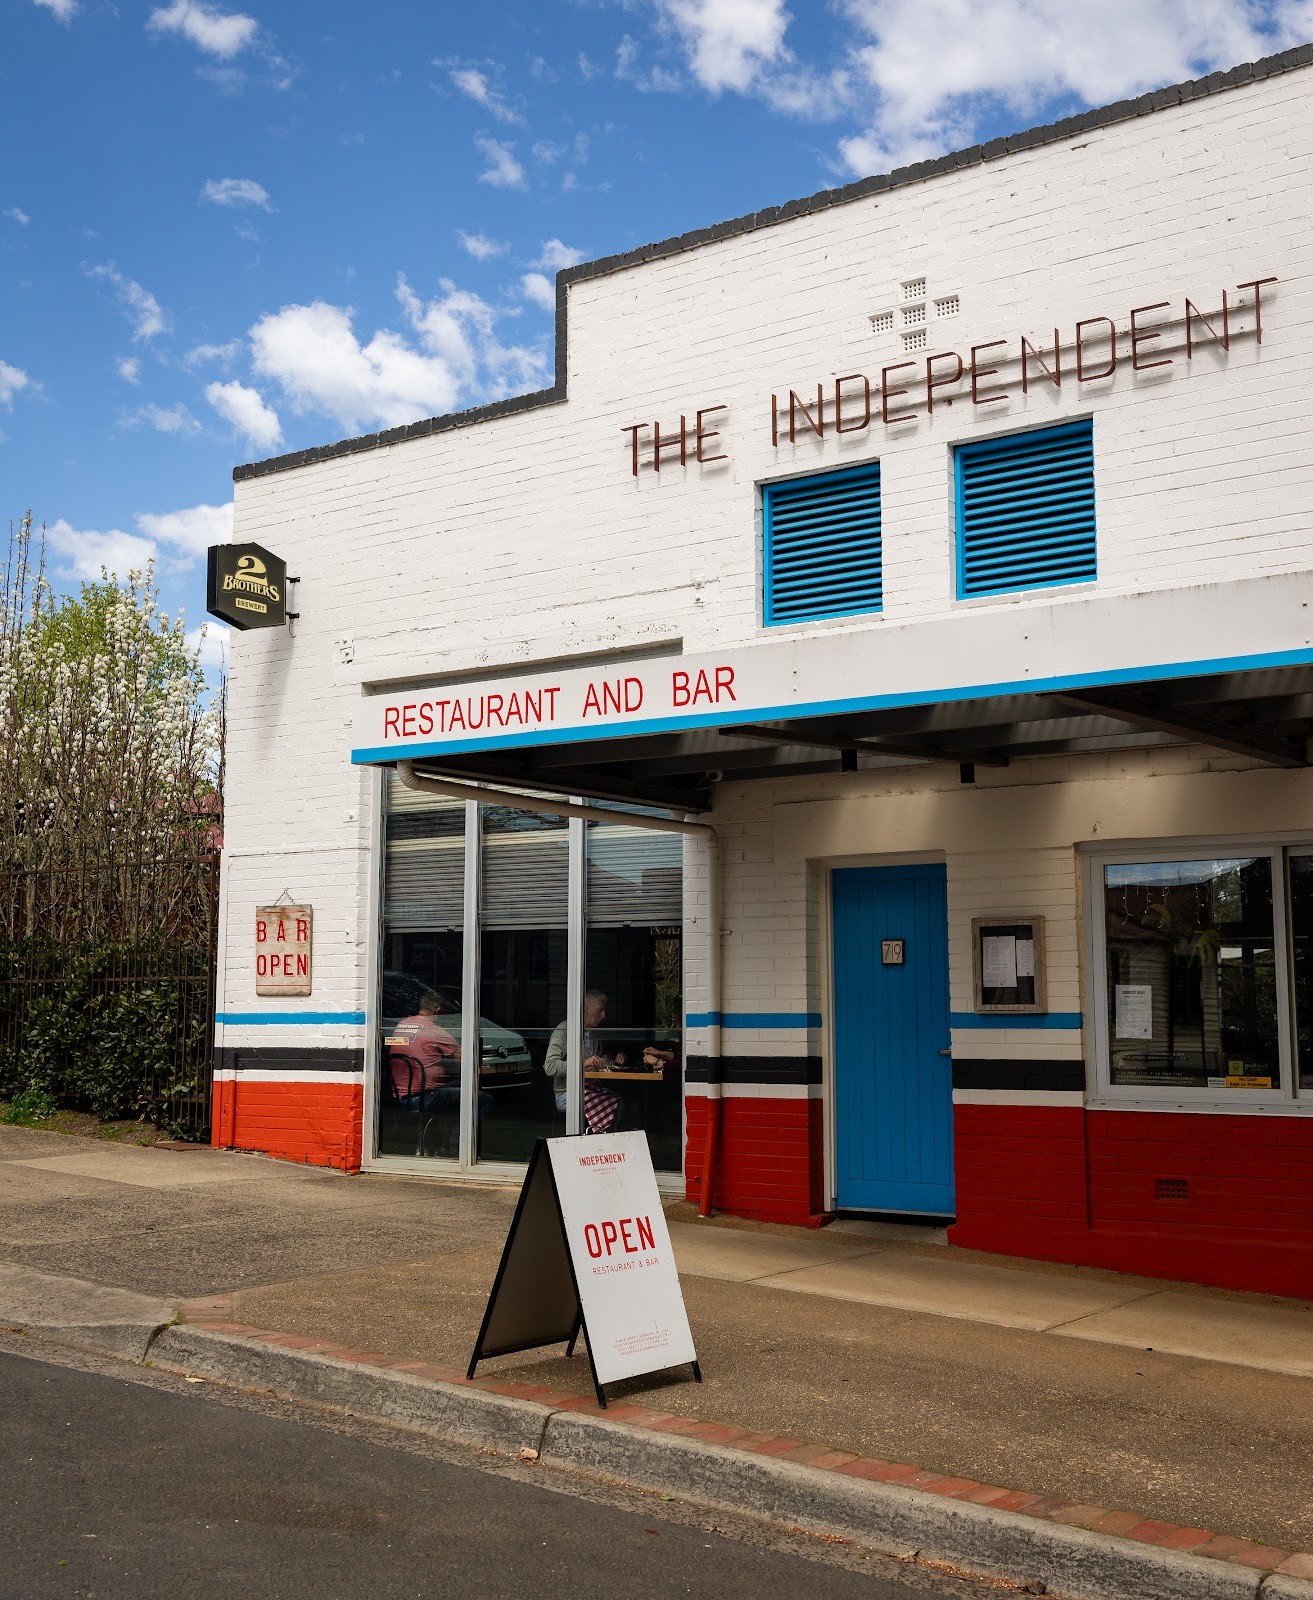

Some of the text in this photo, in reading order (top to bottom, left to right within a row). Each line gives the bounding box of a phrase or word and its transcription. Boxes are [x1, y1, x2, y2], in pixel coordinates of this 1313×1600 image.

[620, 276, 1279, 477] THE INDEPENDENT
[235, 555, 267, 586] 2
[222, 574, 280, 602] BROTHERS
[237, 599, 266, 612] BREWERY
[384, 666, 737, 739] RESTAURANT AND BAR
[257, 918, 308, 943] BAR
[882, 943, 902, 961] 79
[257, 953, 308, 977] OPEN
[578, 1153, 626, 1167] INDEPENDENT
[584, 1216, 656, 1259] OPEN
[592, 1257, 660, 1276] RESTAURANT & BAR
